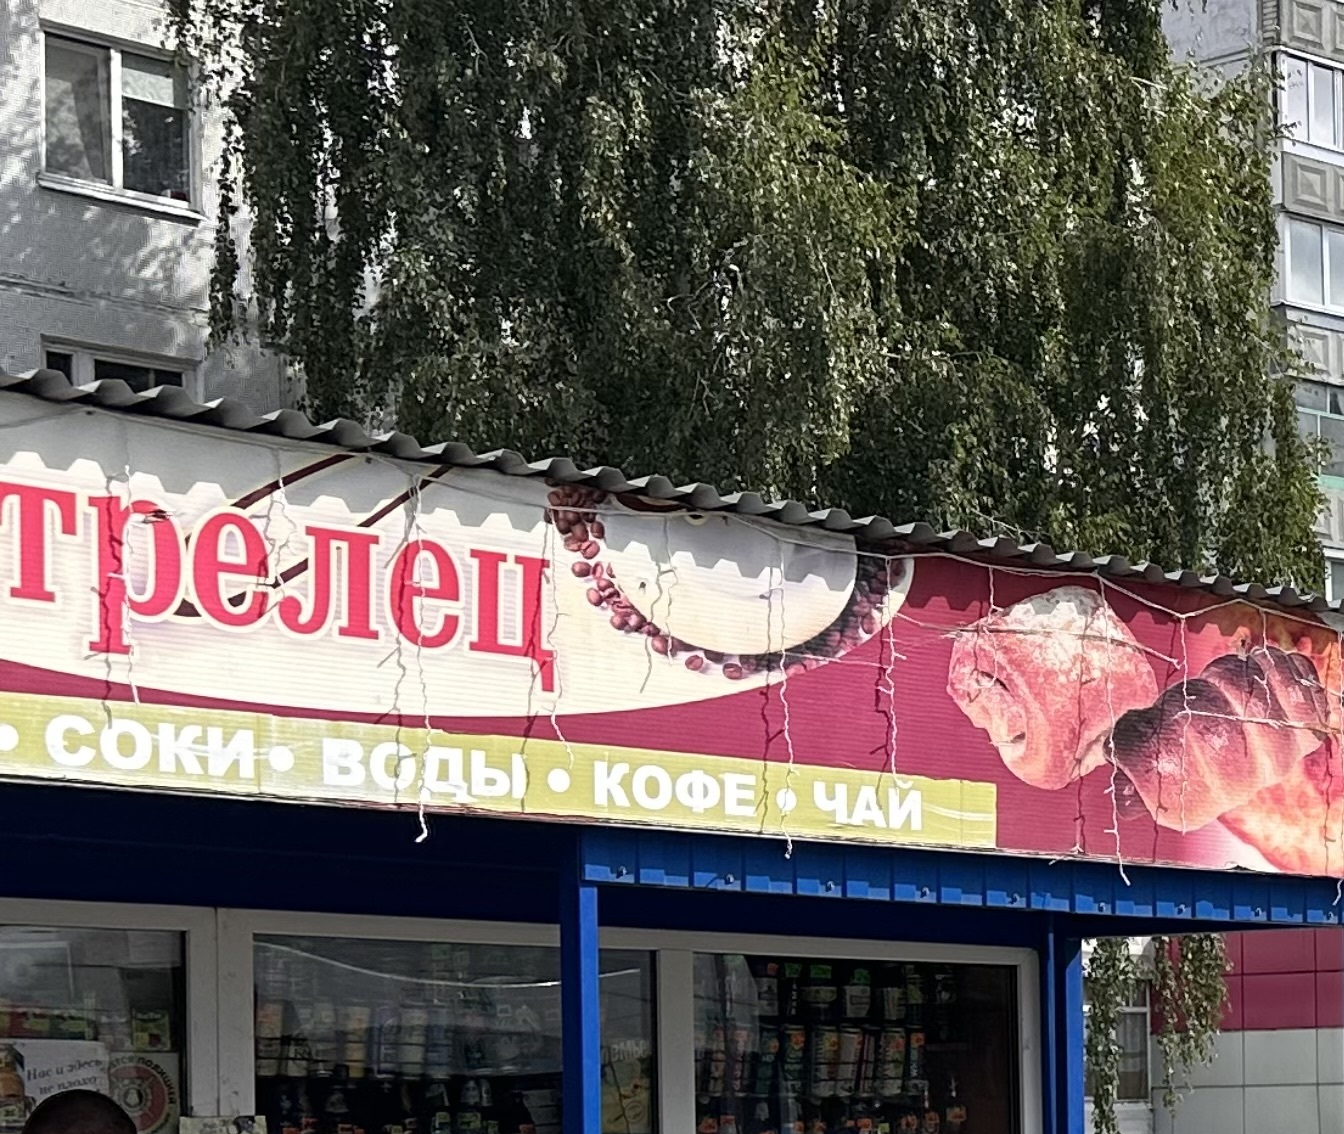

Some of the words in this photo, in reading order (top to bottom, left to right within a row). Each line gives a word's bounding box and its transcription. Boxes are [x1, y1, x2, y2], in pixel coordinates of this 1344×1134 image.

[45, 714, 255, 779] СОКИ
[322, 736, 526, 800] ВОДЫ
[594, 761, 757, 816] КОФЕ
[813, 780, 923, 831] ЧАЙ
